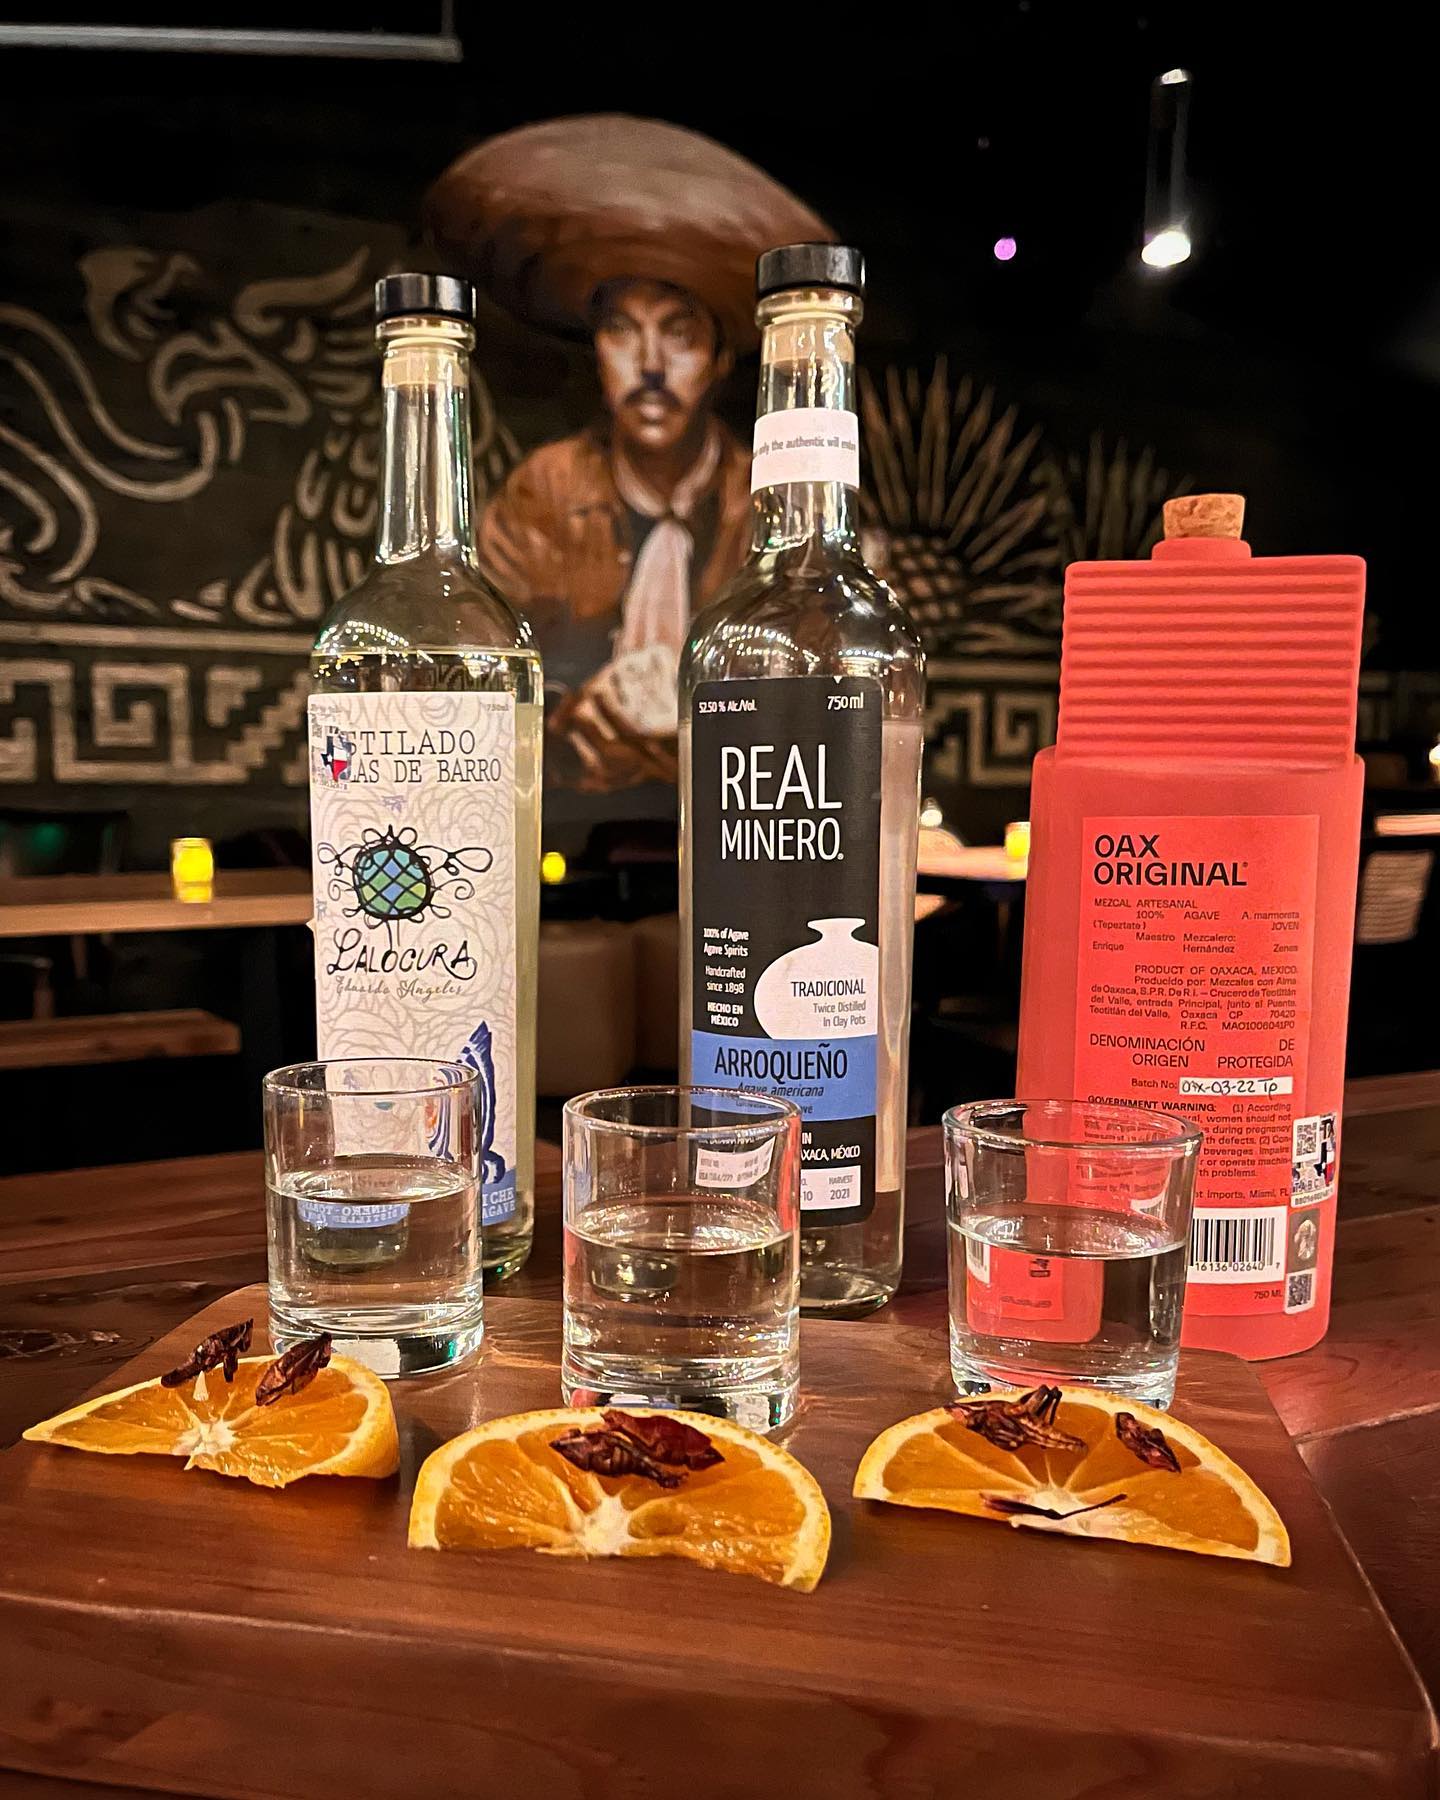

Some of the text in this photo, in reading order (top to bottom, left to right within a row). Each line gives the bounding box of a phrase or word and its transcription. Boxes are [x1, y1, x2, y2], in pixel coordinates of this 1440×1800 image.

[772, 440, 784, 451] the
[786, 436, 825, 449] authentic
[344, 729, 476, 755] STILADO
[393, 760, 422, 783] DE
[437, 758, 501, 783] BARRO
[721, 744, 843, 811] REAL
[1094, 834, 1160, 859] OAX
[1094, 898, 1198, 909] MEZCAL ARTESANAL
[1136, 910, 1165, 919] 100%
[1183, 911, 1220, 920] AGAVE
[1271, 921, 1299, 931] JOVEN
[703, 927, 749, 942] 100% of Agave
[1135, 932, 1237, 942] Maestro Mezcalero:
[703, 942, 749, 958] Agave Spirits
[1092, 941, 1125, 951] Enrique
[1183, 943, 1235, 954] Hernández
[705, 965, 746, 979] Handcrafted
[1134, 964, 1185, 975] PRODUCT
[1190, 966, 1205, 975] OF
[1210, 966, 1257, 976] OAXACA,
[335, 975, 391, 996] Eduardo
[706, 981, 745, 994] since 1898
[790, 978, 866, 997] TRADICIONAL
[1134, 976, 1184, 986] Producido
[1210, 978, 1254, 986] Mezcales
[1257, 978, 1274, 986] con
[1091, 984, 1102, 993] de
[1103, 985, 1139, 995] Oaxaca,
[1168, 988, 1182, 997] De
[1209, 988, 1248, 998] Crucero
[1248, 988, 1260, 997] de
[707, 1002, 744, 1015] HECHO EN
[813, 1000, 867, 1013] Twice Distilled
[1090, 995, 1104, 1004] del
[1108, 996, 1132, 1006] Valle,
[1136, 999, 1173, 1007] entrada
[1178, 999, 1223, 1009] Principal,
[1226, 999, 1251, 1010] junto
[1089, 1005, 1296, 1019] Teotitlán del Valle, Oaxaca CP 70420
[710, 1014, 739, 1027] MÉXICO
[823, 1014, 866, 1028] In Clay Pots
[1090, 1033, 1296, 1052] DENOMINACIÓN DE
[714, 1042, 848, 1085] ARROQUEÑO
[1132, 1053, 1294, 1069] ORIGEN PROTEGIDA
[1131, 1078, 1177, 1089] Batch No:
[770, 1084, 824, 1097] americana
[1088, 1095, 1292, 1113] GOVERNMENT WARNING: (1) According
[1206, 1115, 1242, 1123] women
[1246, 1113, 1275, 1123] should
[1212, 1125, 1243, 1135] during
[1246, 1125, 1292, 1135] pregnancy
[1218, 1136, 1257, 1145] defects.
[1259, 1136, 1270, 1145] (2)
[830, 1144, 860, 1160] MÉXICO
[1203, 1146, 1290, 1157] beverages impairs
[1220, 1159, 1256, 1168] operate
[828, 1175, 854, 1185] HARVEST
[1211, 1169, 1258, 1178] problems.
[830, 1188, 850, 1200] 2021
[1207, 1190, 1246, 1199] Imports,
[1232, 1262, 1264, 1272] 02640
[1253, 1290, 1270, 1300] 750
